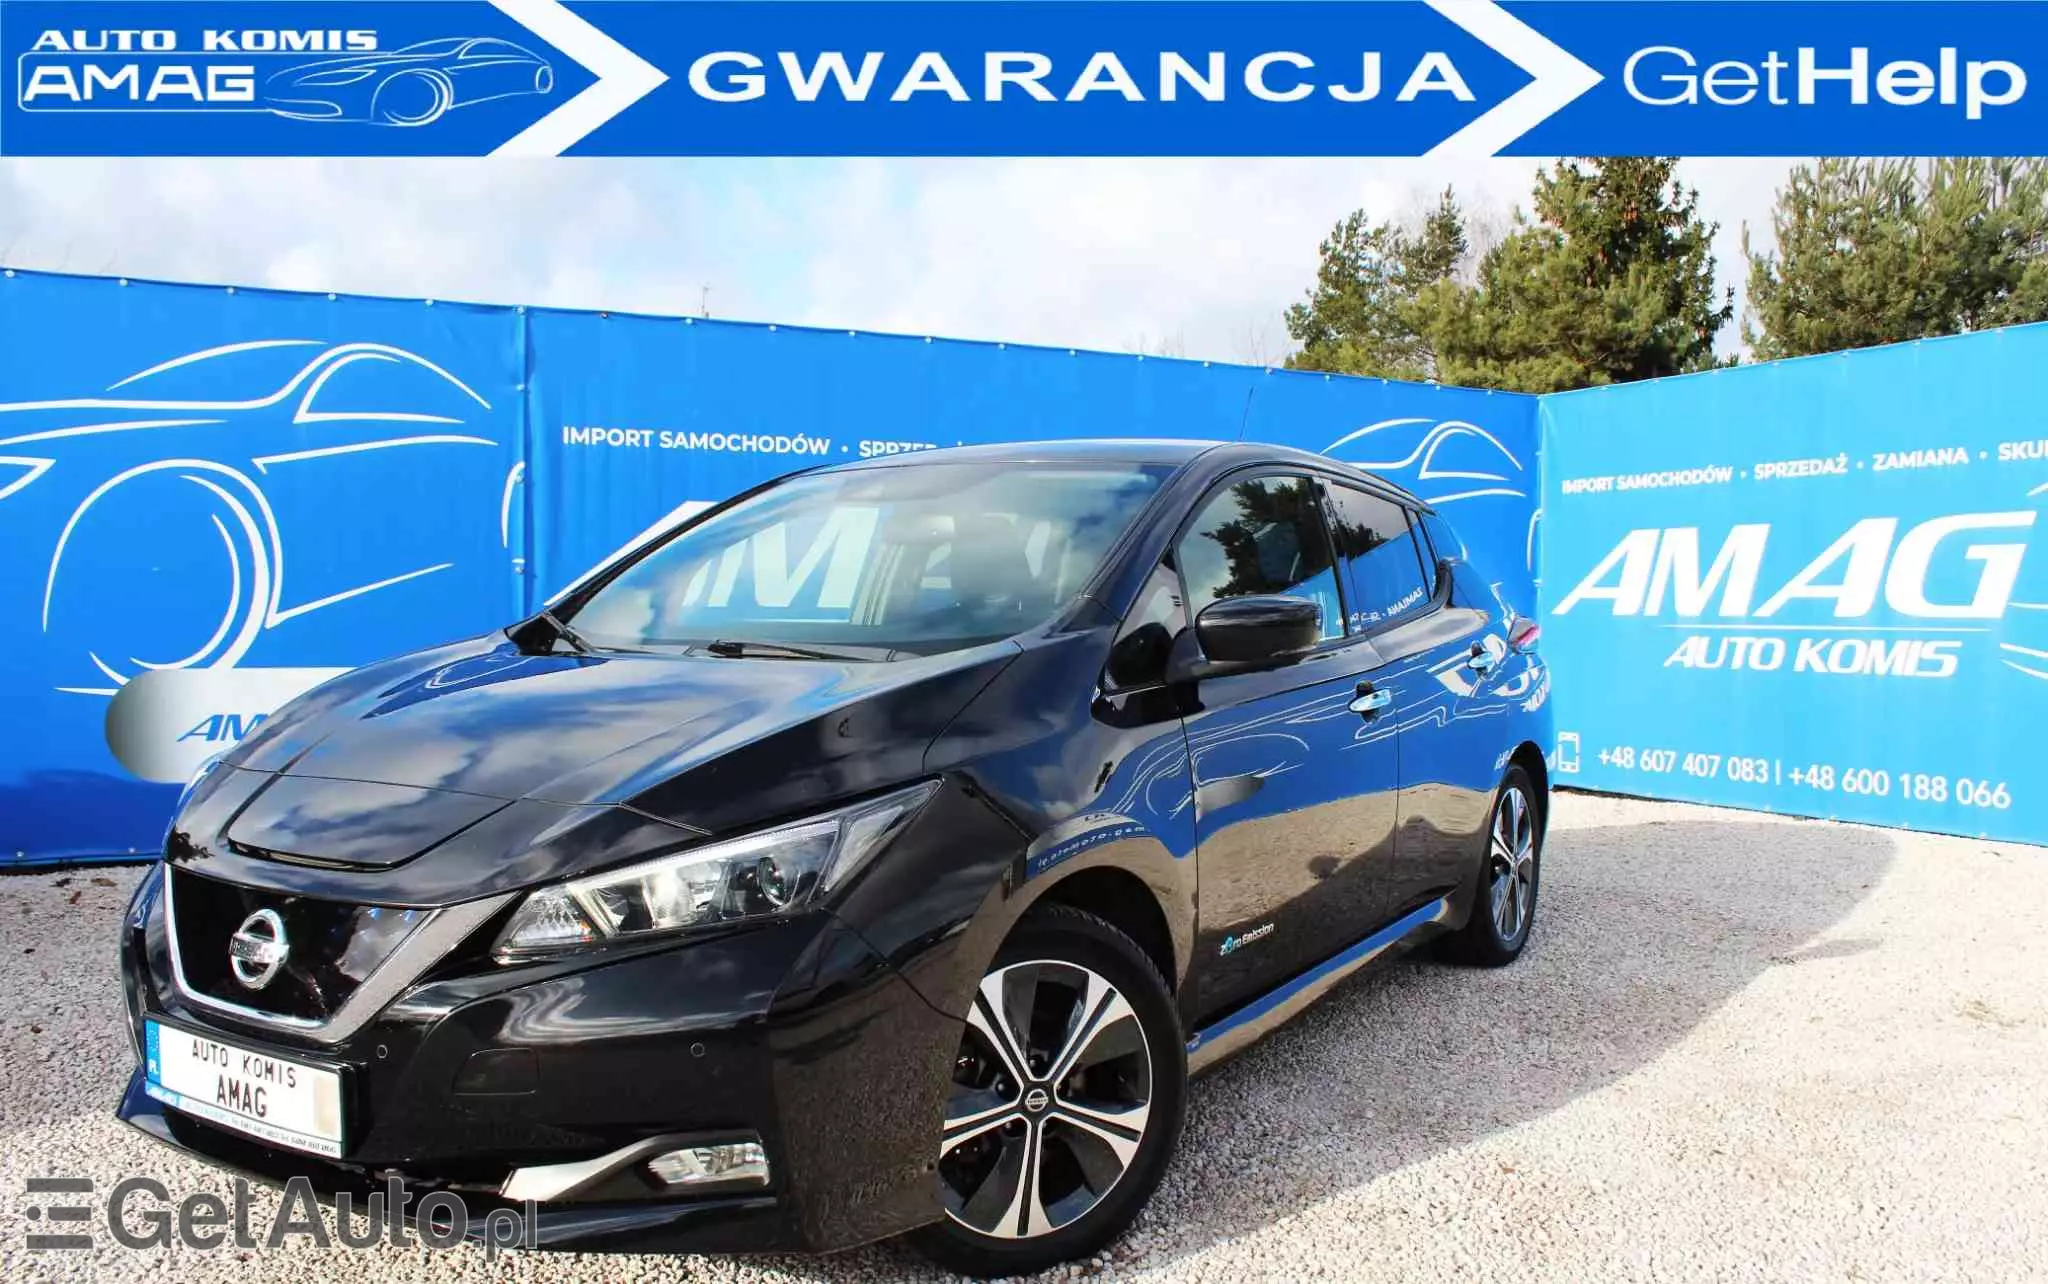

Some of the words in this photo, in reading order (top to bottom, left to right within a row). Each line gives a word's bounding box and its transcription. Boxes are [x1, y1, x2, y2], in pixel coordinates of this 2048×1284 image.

[562, 426, 654, 448] IMPORT
[659, 431, 831, 456] SAMOCHODÓW
[1561, 476, 1615, 495] IMPORT
[1616, 463, 1733, 491] SAMOCHODÓW
[1754, 452, 1848, 480] SPRZEDAŻ
[1872, 446, 1969, 471] ZAMIANA
[1998, 440, 2048, 461] SKU
[1552, 510, 2037, 619] AMAG
[1663, 636, 1786, 671] AUTO
[1792, 638, 1962, 678] KOMIS
[176, 714, 269, 742] AM
[1599, 746, 1635, 769] +48
[1639, 749, 1676, 773] 607
[1682, 752, 1720, 778] 407
[1727, 756, 1769, 784] 083
[1788, 764, 1835, 791] +48
[1841, 768, 1889, 796] 600
[1899, 773, 1948, 802] 188
[1955, 778, 2011, 809] 066
[192, 1039, 228, 1068] AUTO
[243, 1054, 296, 1088] KOMIS
[216, 1074, 268, 1118] AMAG
